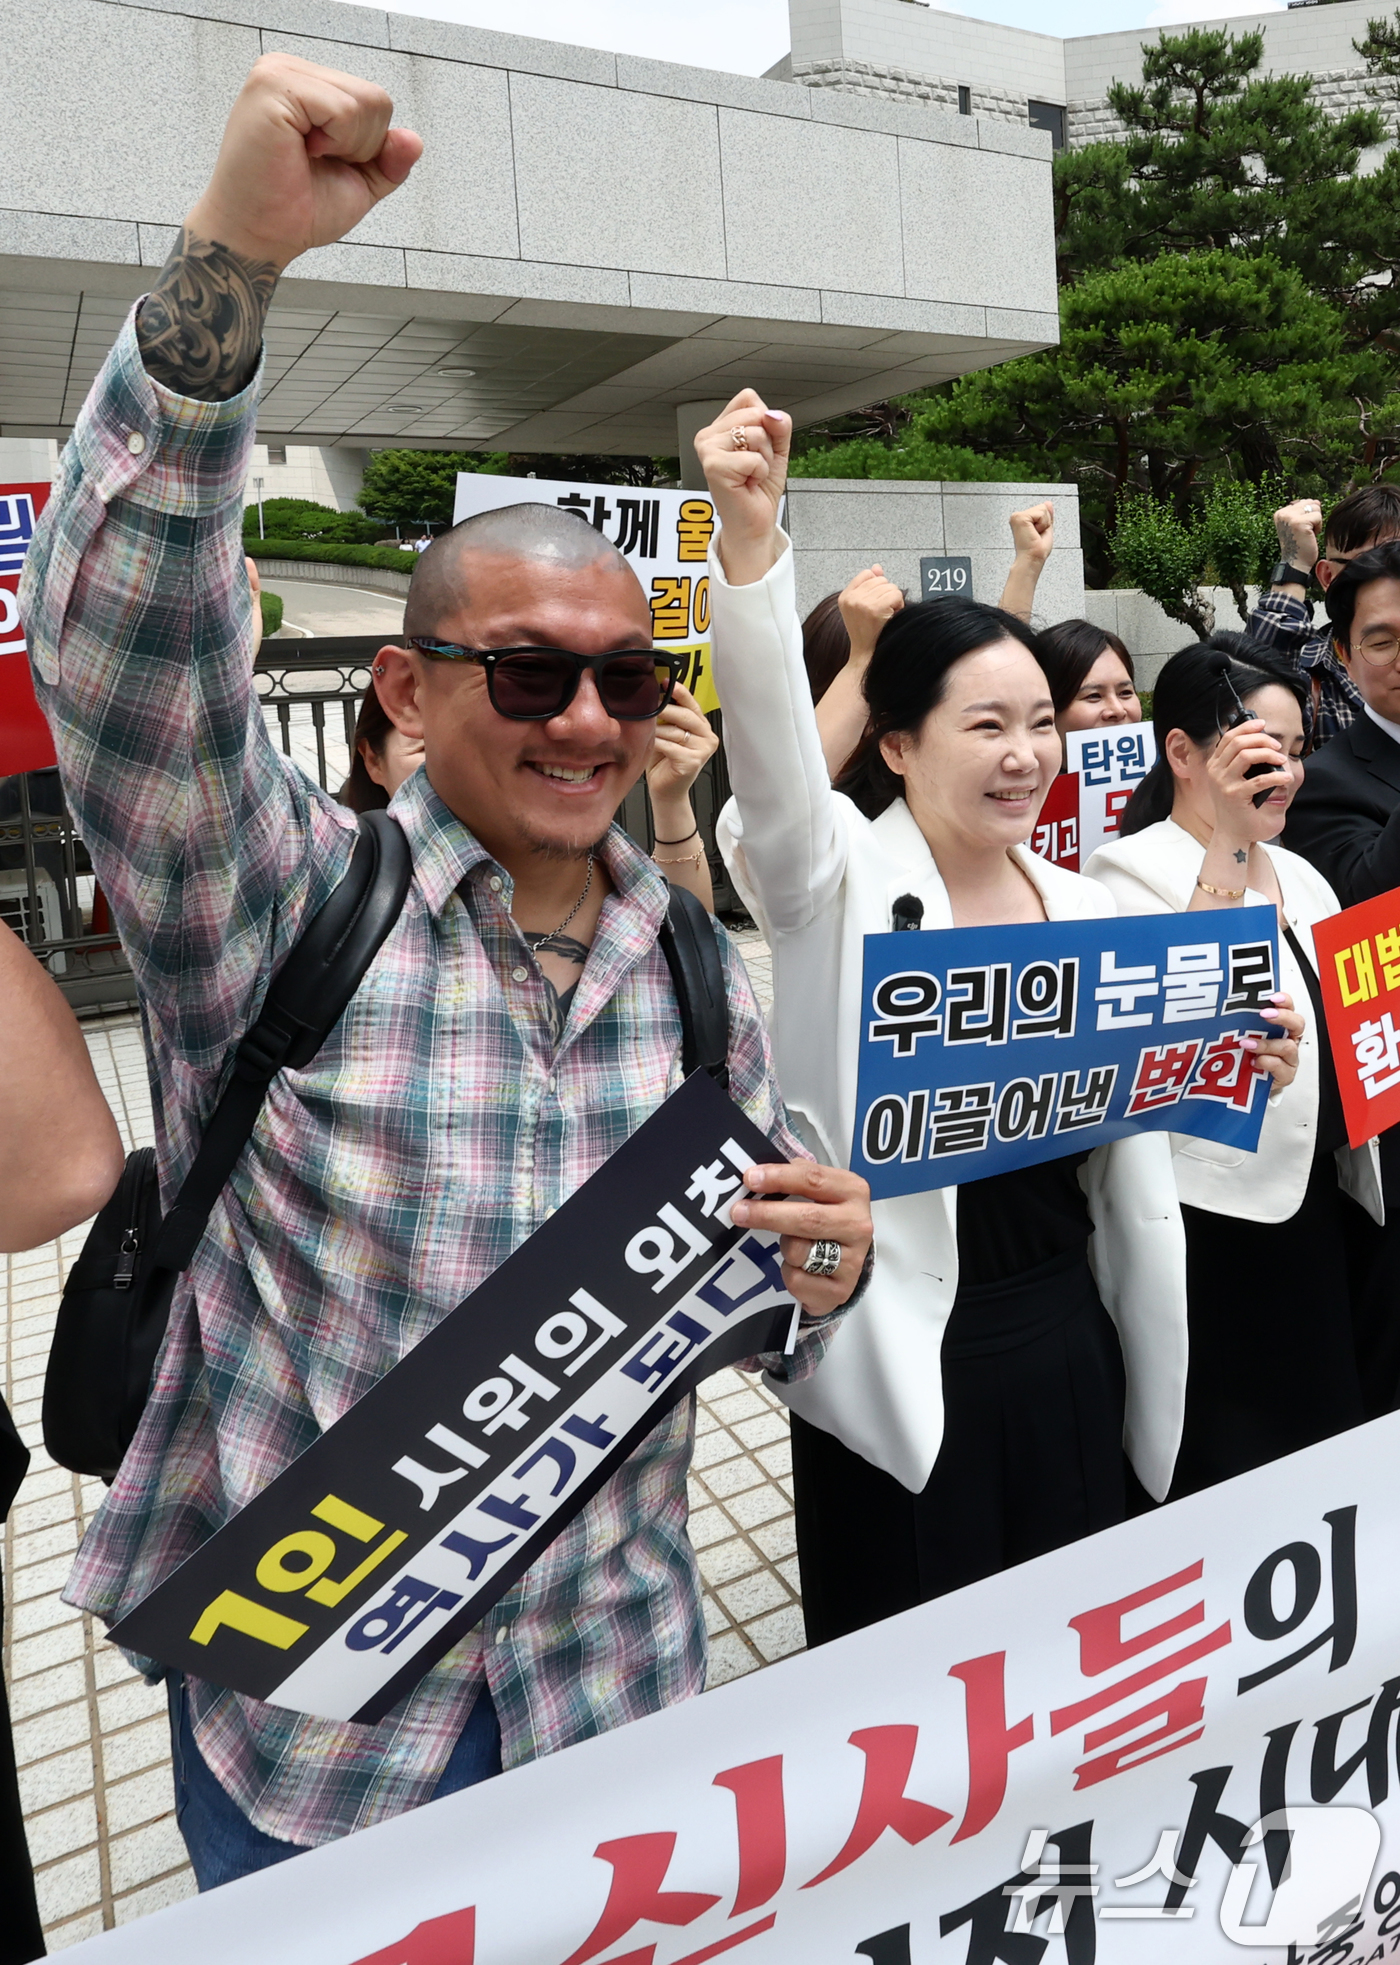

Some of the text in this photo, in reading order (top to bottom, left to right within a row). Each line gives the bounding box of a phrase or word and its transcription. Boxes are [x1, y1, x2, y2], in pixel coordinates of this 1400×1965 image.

[927, 567, 967, 592] 219
[1081, 734, 1160, 787] 탄원
[1024, 816, 1078, 862] 키고
[868, 940, 1276, 1058] 우리의 눈물로
[861, 1029, 1270, 1165] 이끌어낸 변화
[188, 1494, 408, 1651] 1인
[391, 1287, 627, 1511] 시위의
[344, 1236, 787, 1655] 역사가 되다
[348, 1504, 1358, 1965] 신사들의
